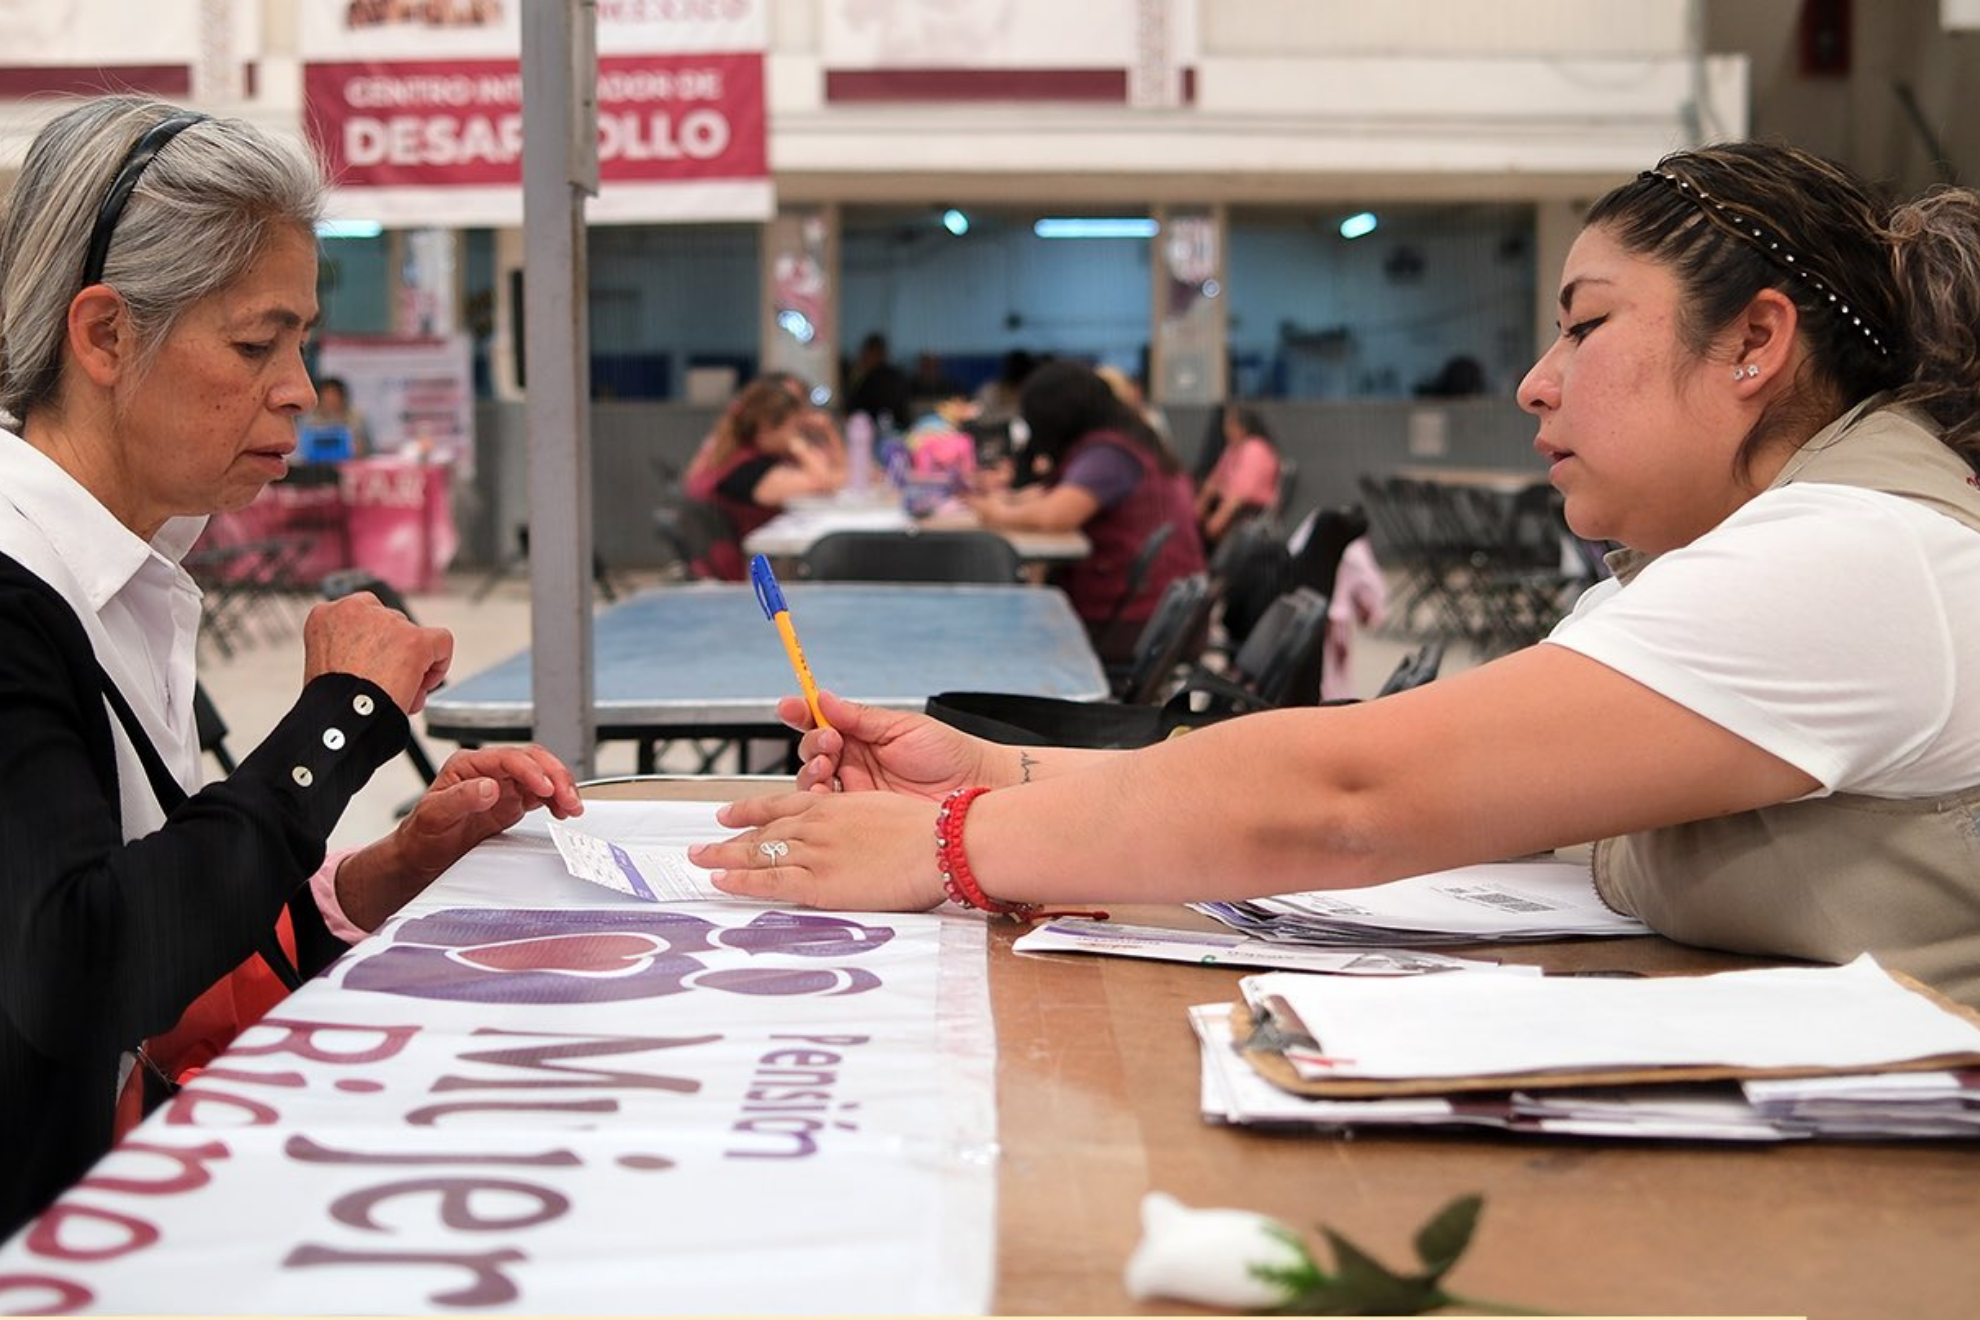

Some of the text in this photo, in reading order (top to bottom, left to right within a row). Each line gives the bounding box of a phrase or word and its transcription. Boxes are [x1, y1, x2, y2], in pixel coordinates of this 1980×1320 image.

[344, 75, 473, 107] CENTRO
[676, 69, 724, 100] DE
[723, 1033, 871, 1158] Pensión
[281, 1027, 725, 1308] Mujer
